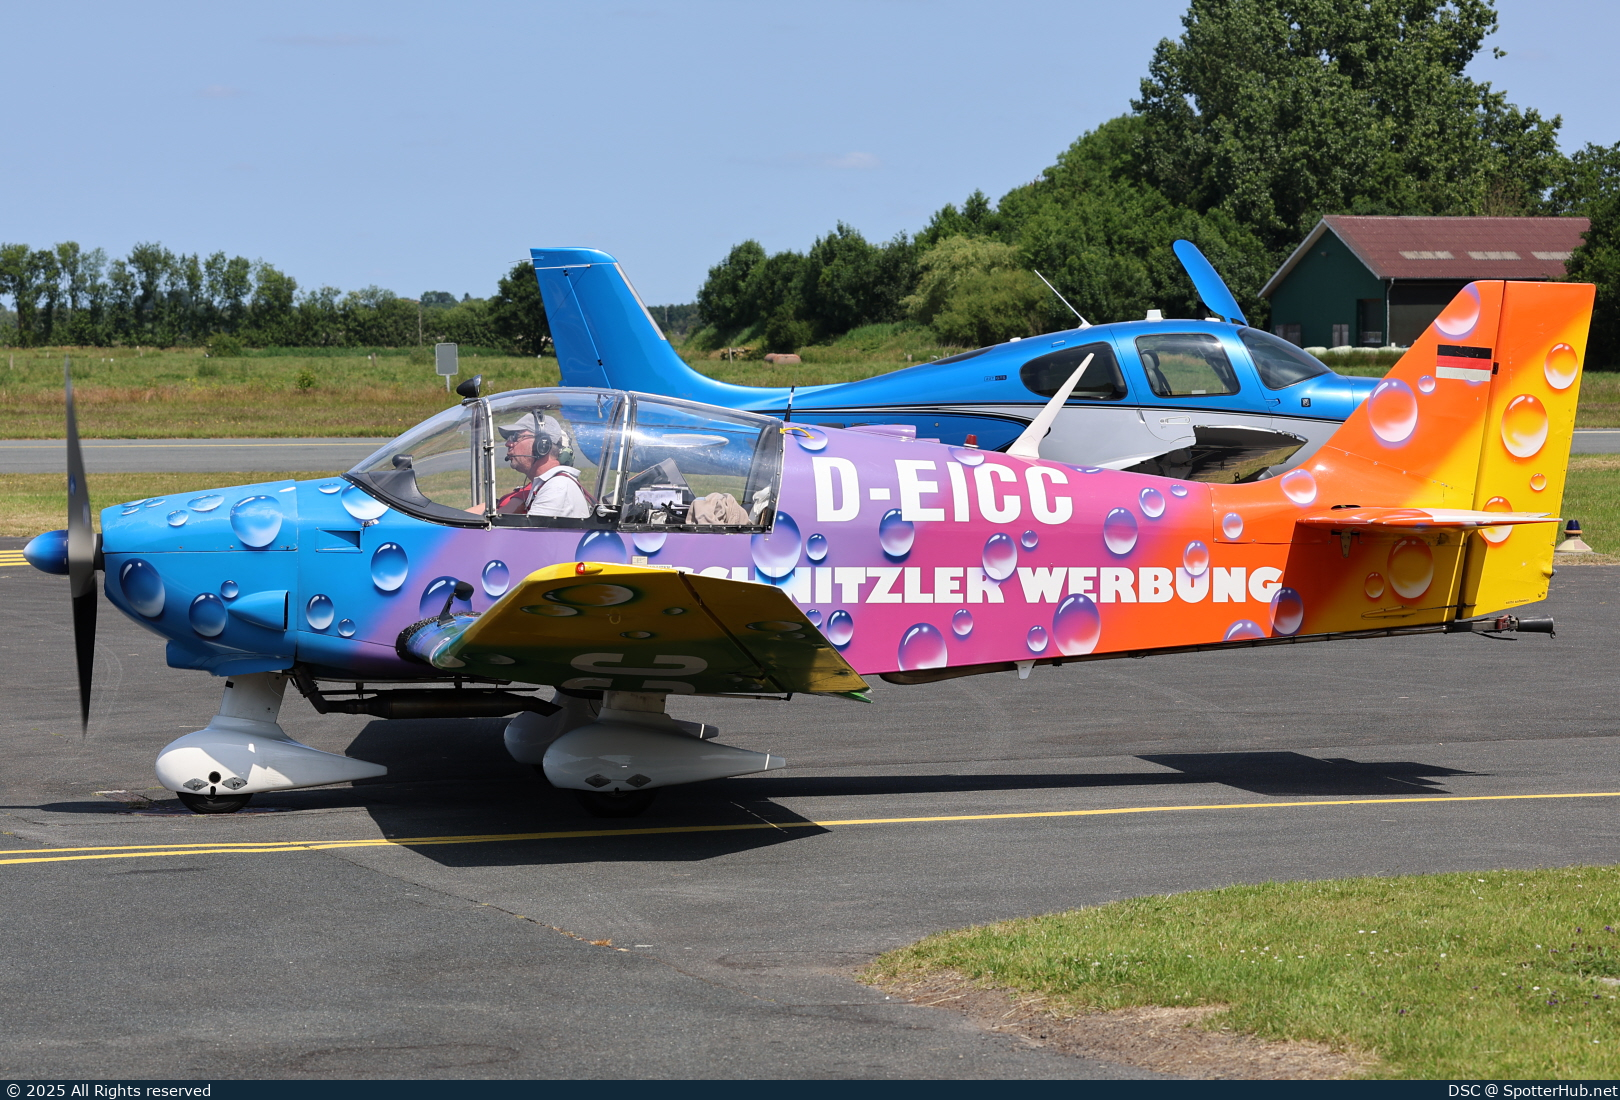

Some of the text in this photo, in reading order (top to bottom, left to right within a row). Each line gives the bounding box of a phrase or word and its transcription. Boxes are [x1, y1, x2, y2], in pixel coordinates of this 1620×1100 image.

[812, 456, 1073, 525] D-EICC
[673, 566, 1283, 603] NITZLER WERBUNG
